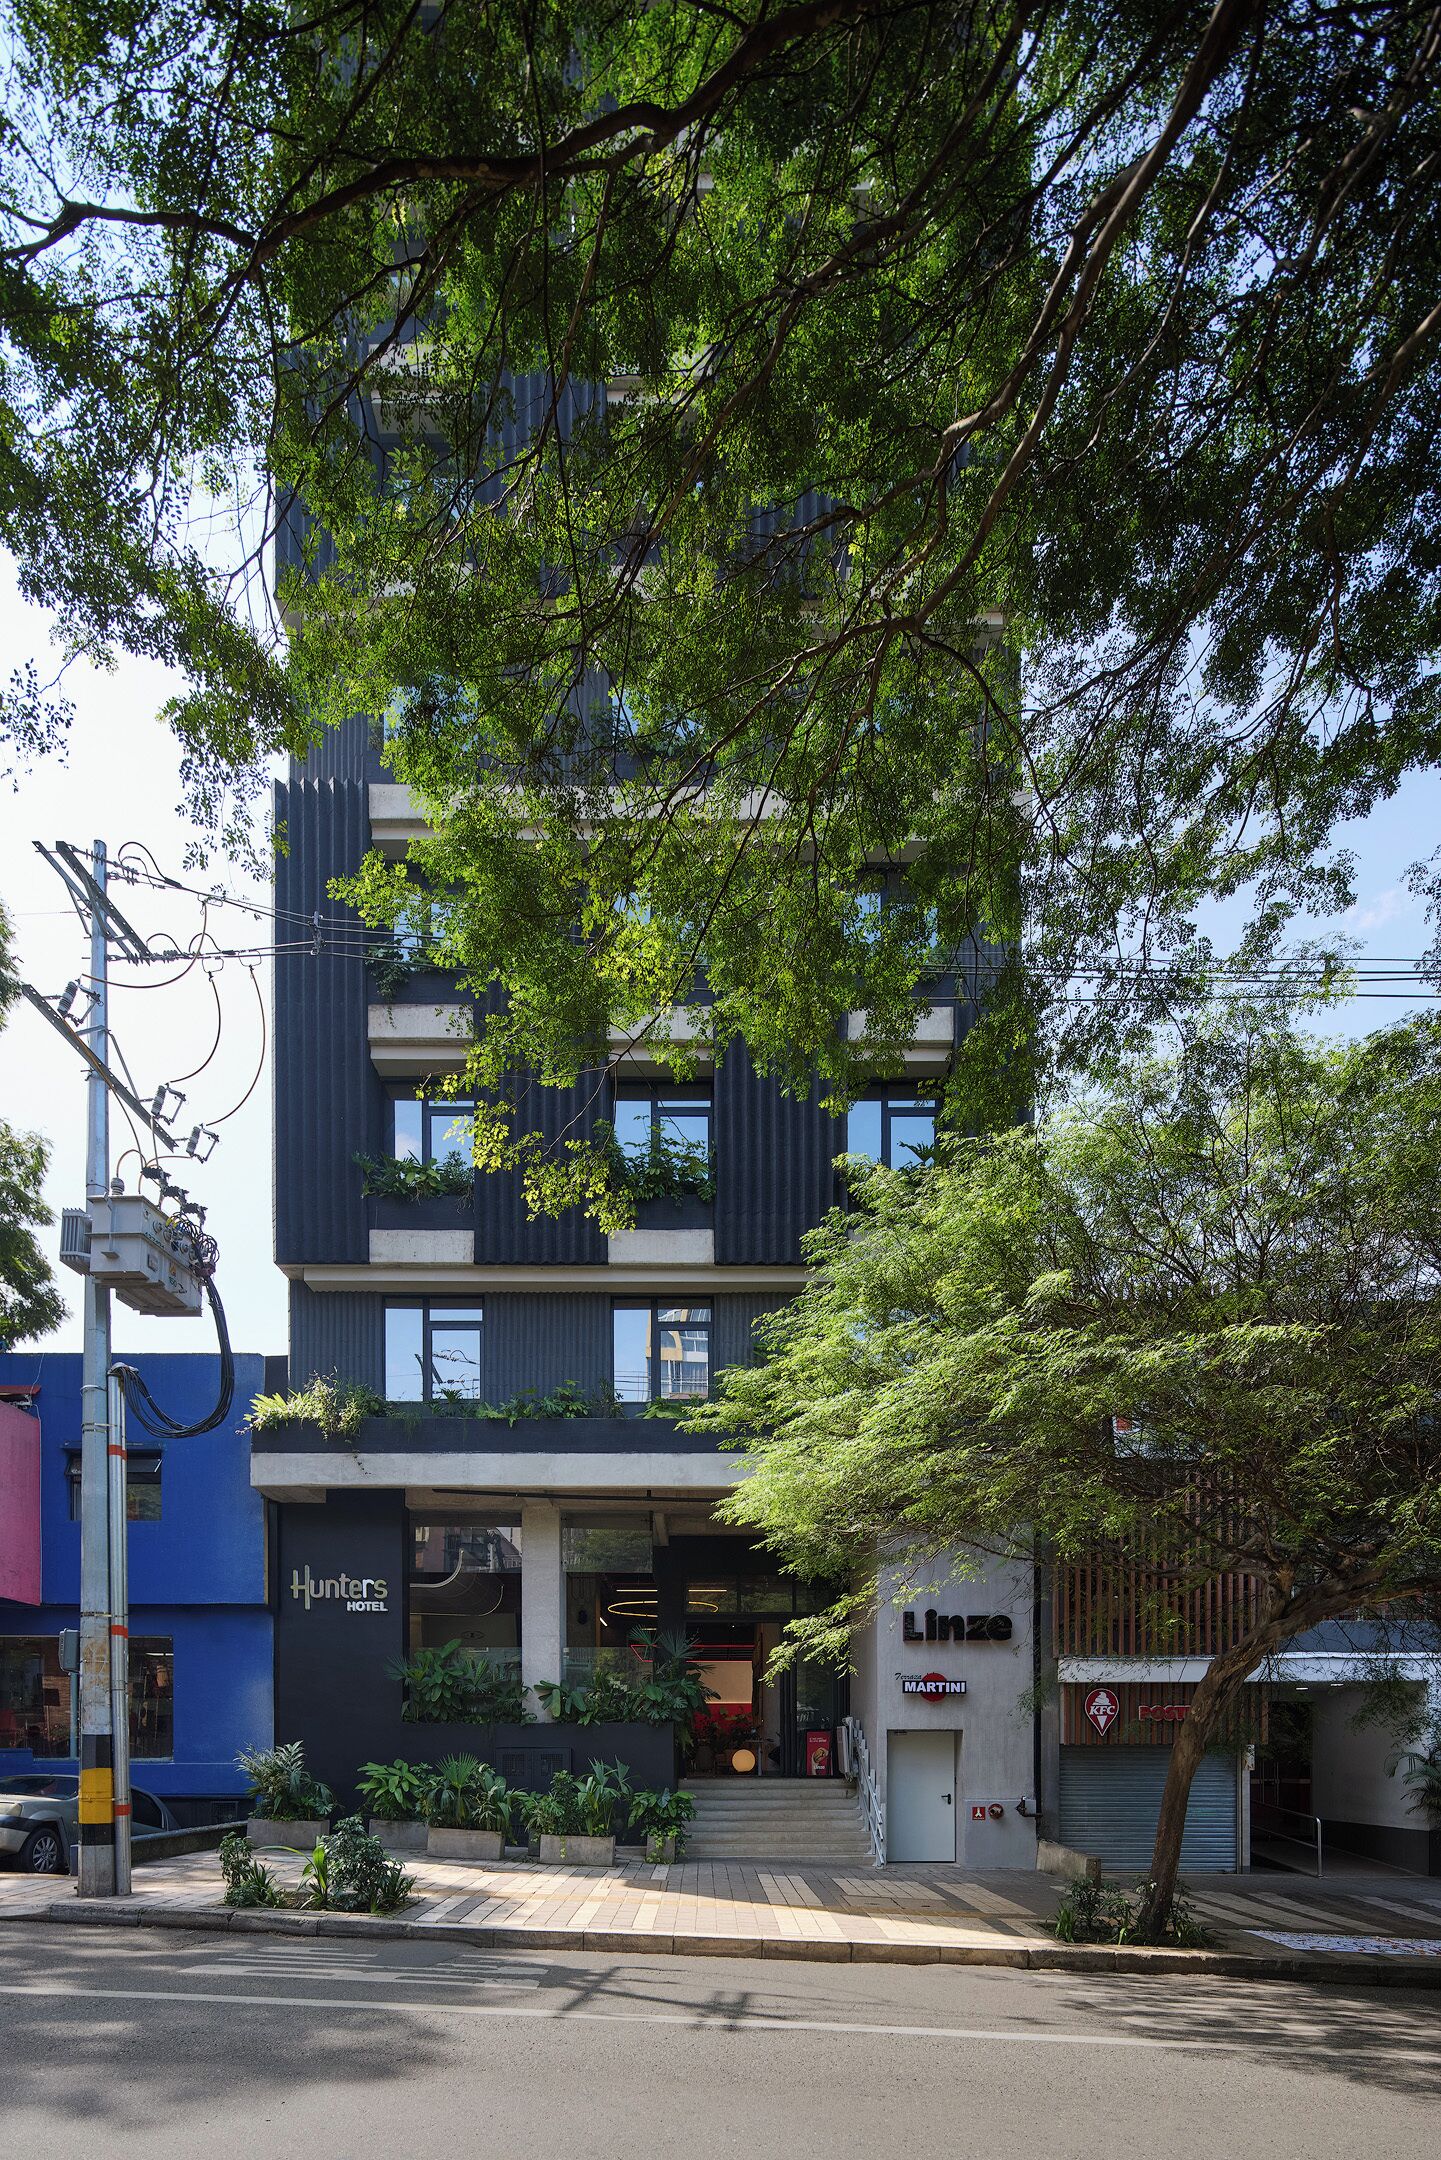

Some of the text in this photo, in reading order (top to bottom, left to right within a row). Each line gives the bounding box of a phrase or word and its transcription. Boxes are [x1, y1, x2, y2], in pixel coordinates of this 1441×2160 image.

[290, 1564, 388, 1610] Hunters
[346, 1601, 389, 1612] HOTEL
[902, 1608, 1013, 1641] Linze
[904, 1681, 966, 1693] MARTINI
[1089, 1705, 1116, 1716] KFC
[1138, 1704, 1191, 1721] POST
